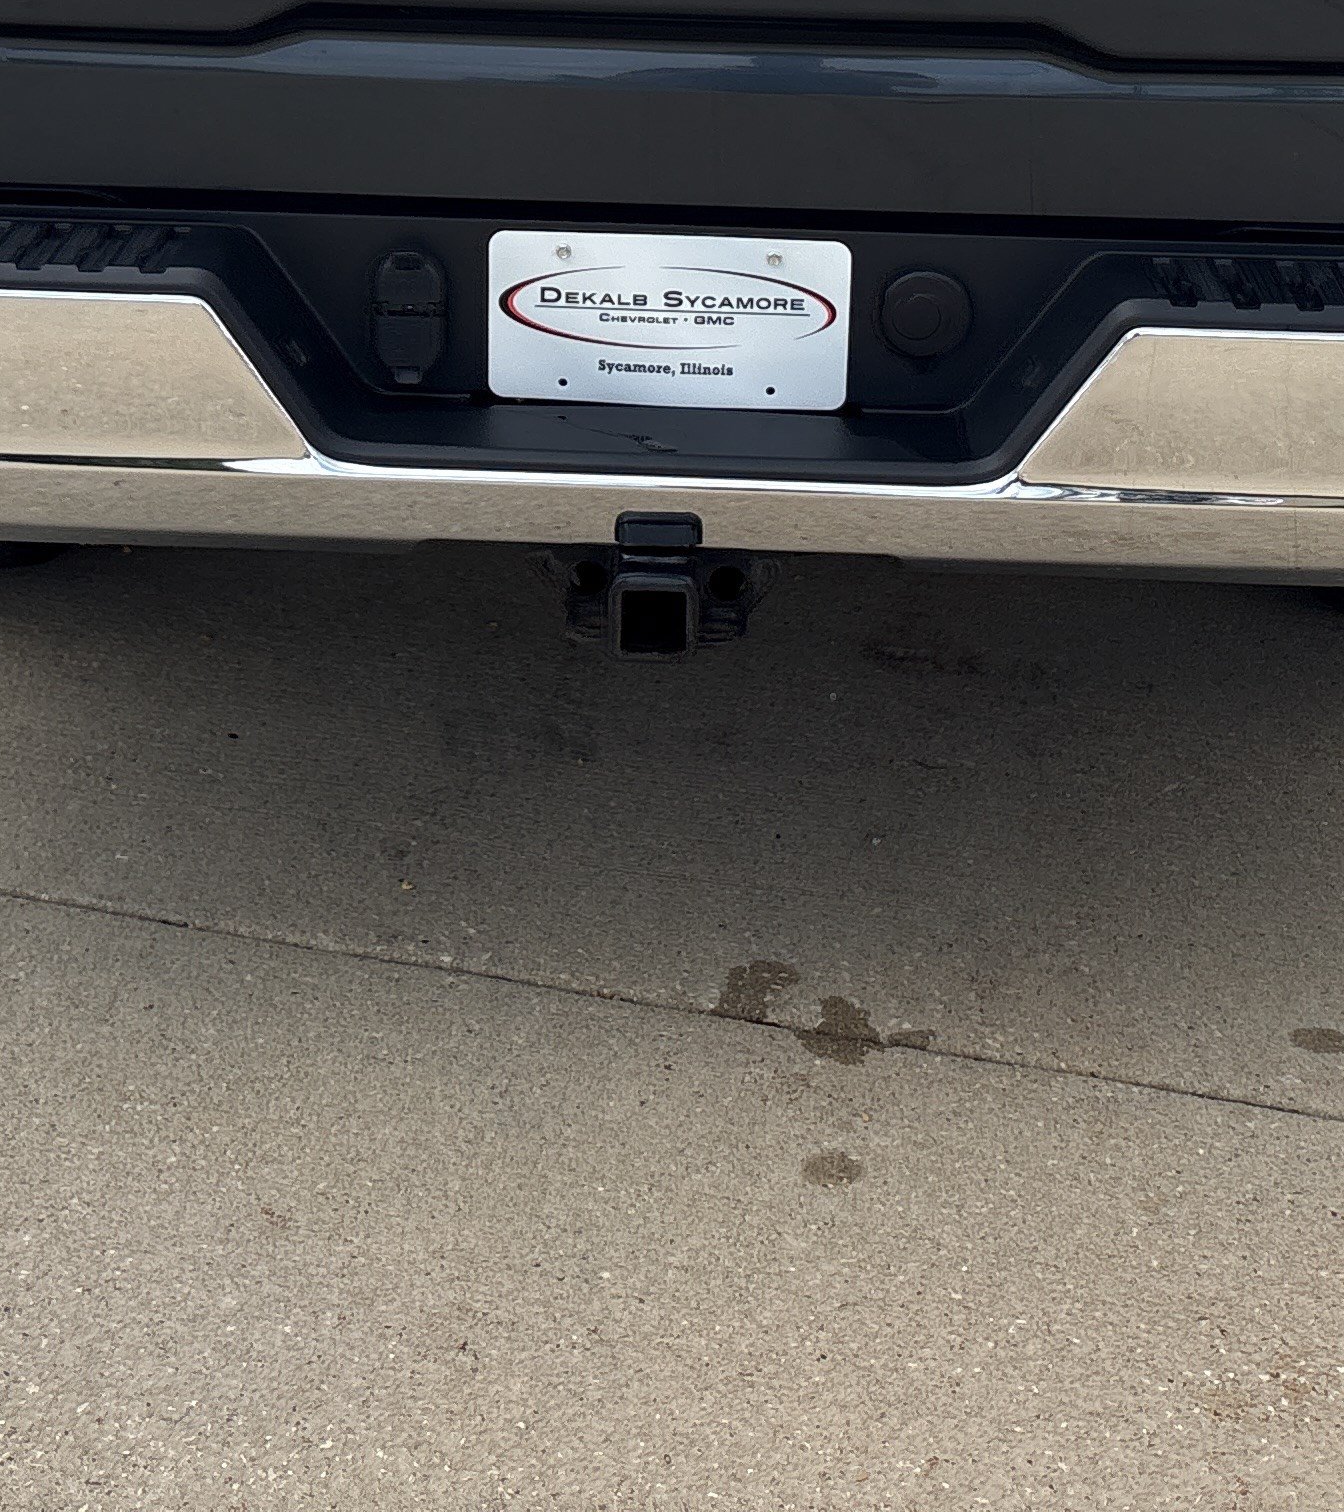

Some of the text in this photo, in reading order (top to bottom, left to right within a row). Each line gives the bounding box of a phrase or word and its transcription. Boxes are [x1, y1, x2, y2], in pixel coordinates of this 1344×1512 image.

[539, 286, 806, 311] DEKALB SYCAMORE
[598, 312, 735, 326] CHEVROLET GMC
[597, 359, 734, 377] Sycamore, Illinois
